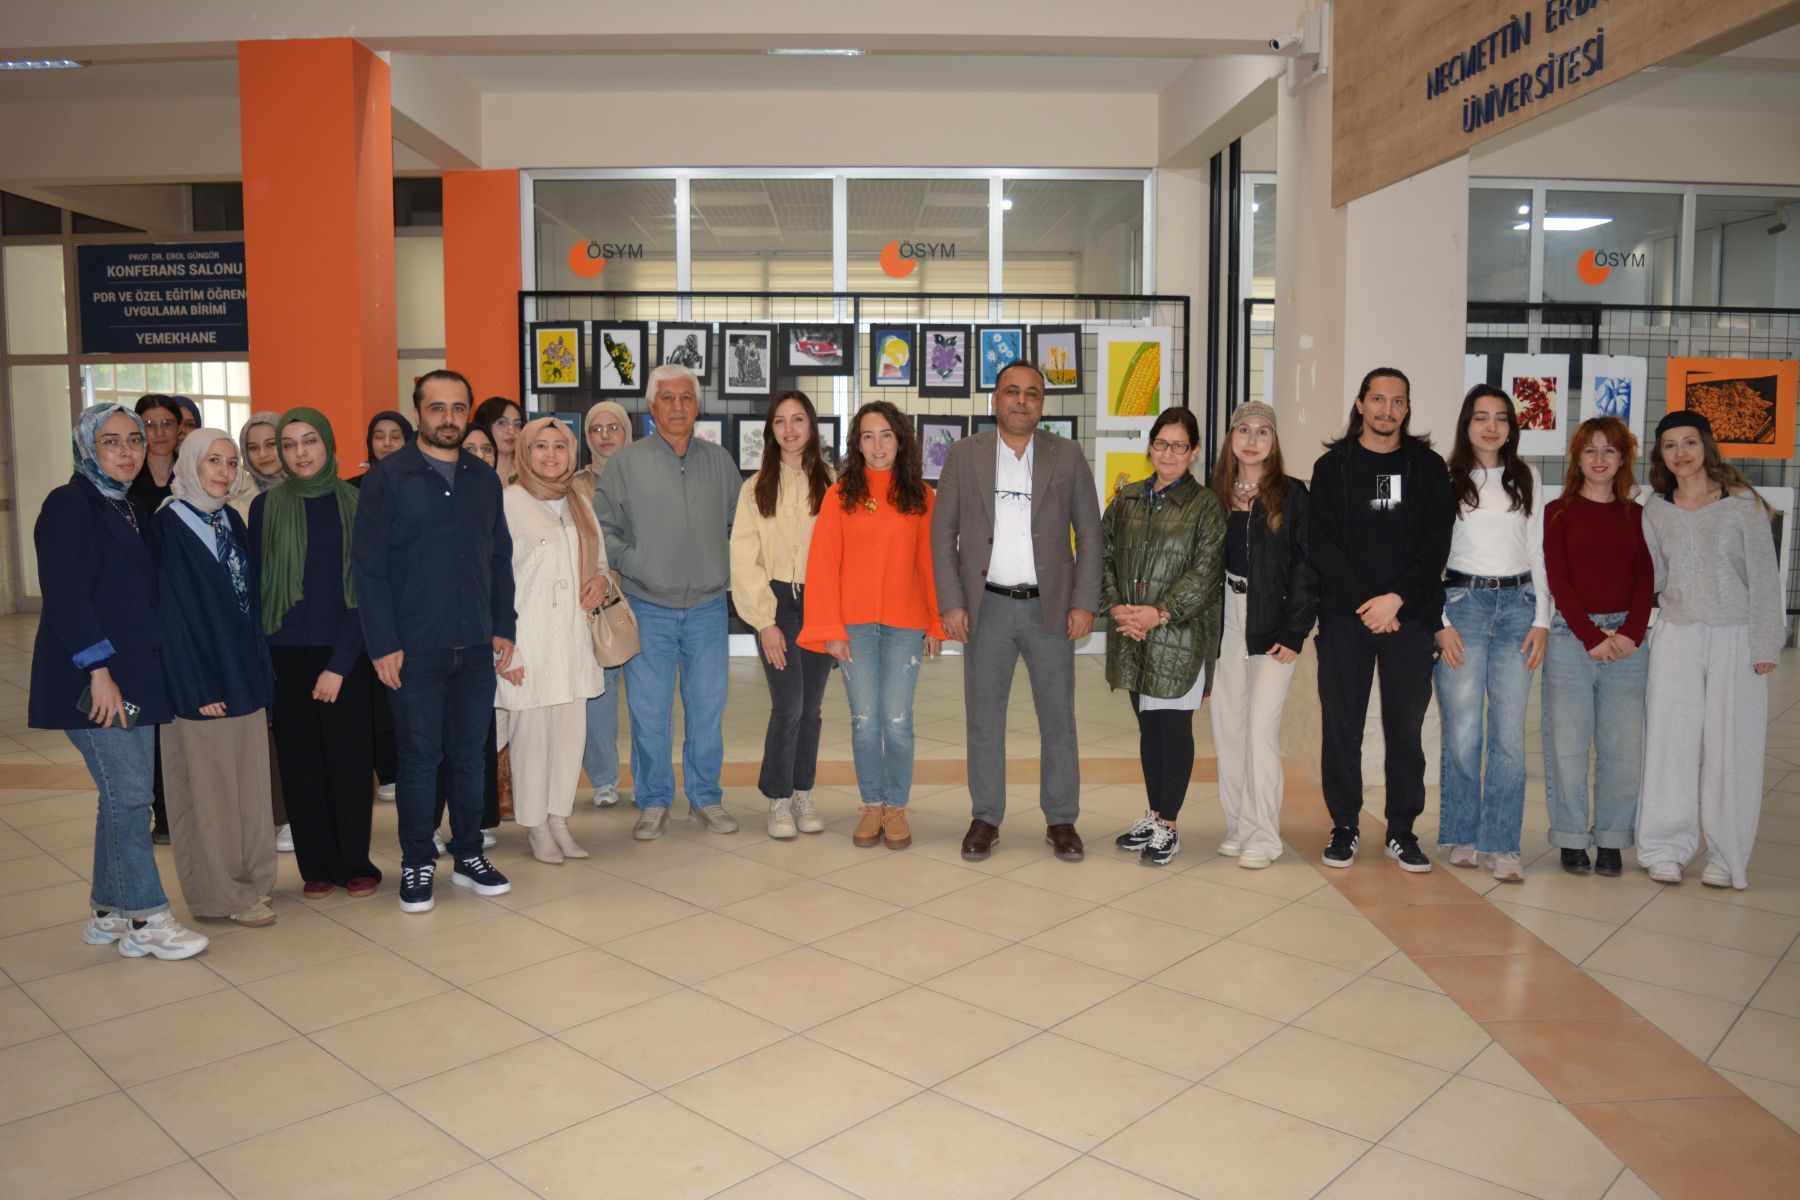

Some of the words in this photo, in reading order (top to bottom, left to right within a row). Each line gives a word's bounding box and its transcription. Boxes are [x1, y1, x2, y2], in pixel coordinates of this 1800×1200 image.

[1427, 12, 1531, 100] NECMETTİN
[1545, 0, 1597, 33] ER
[1462, 27, 1604, 133] ÜNİVERSİTESİ
[166, 252, 186, 260] EROL
[187, 251, 220, 260] GÜNGÖR
[587, 240, 643, 259] ÖSYM
[899, 240, 955, 259] ÖSYM
[1594, 249, 1645, 267] ÖSYM
[107, 264, 186, 277] KONFERANS
[189, 262, 243, 275] SALONU
[93, 292, 116, 302] PDR
[119, 292, 133, 302] VE
[135, 289, 163, 301] ÖZEL
[166, 288, 204, 301] EĞİTİM
[207, 287, 246, 300] ÖĞREN
[124, 305, 188, 317] UYGULAMA
[190, 302, 227, 315] BİRİMİ
[136, 331, 217, 344] YEMEKHANE
